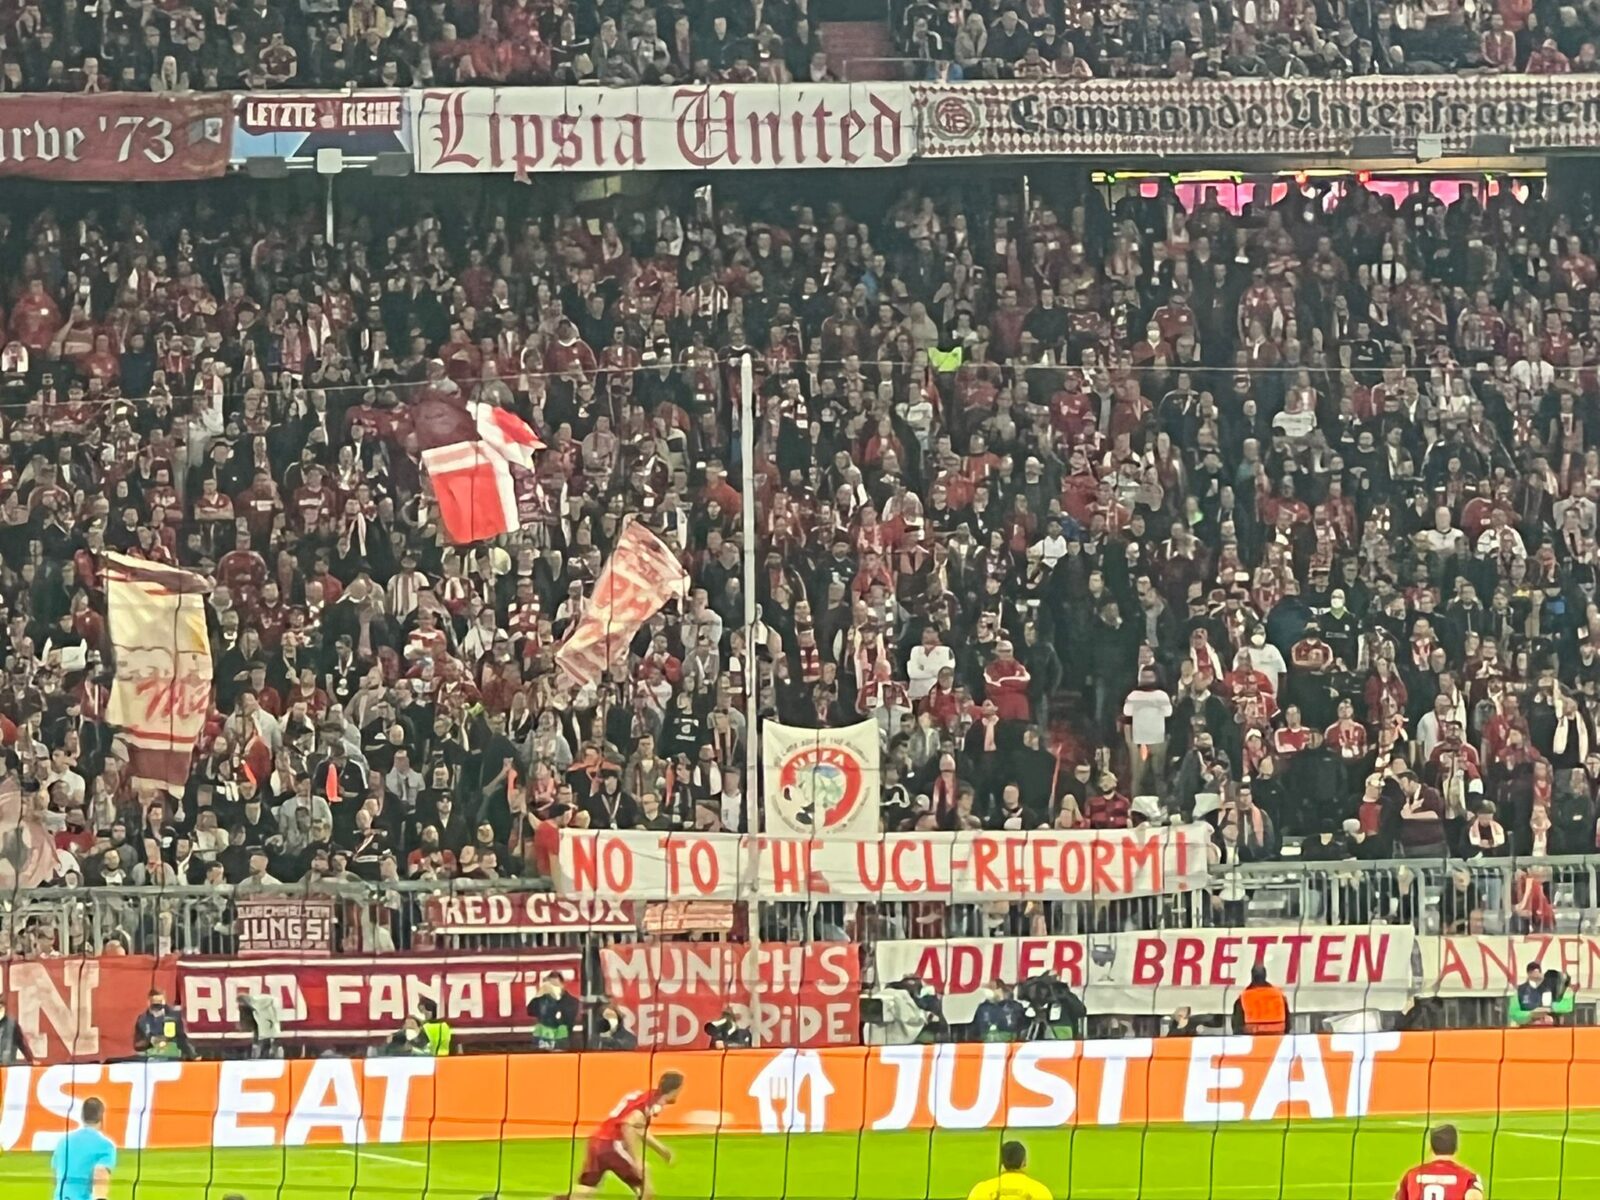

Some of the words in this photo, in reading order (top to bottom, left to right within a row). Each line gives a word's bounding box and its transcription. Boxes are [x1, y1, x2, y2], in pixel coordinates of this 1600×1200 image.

[0, 120, 85, 162] rve
[99, 115, 175, 164] '73
[246, 102, 317, 128] LETZTE
[421, 87, 646, 185] Lipsia
[672, 86, 902, 168] United
[792, 750, 845, 768] UEFA
[572, 836, 633, 893] NO
[658, 838, 719, 895] TO
[239, 918, 330, 940] JUNGS!
[439, 894, 513, 924] RED
[915, 940, 1083, 994] ADLER
[1132, 933, 1390, 985] BRETTEN
[212, 1057, 436, 1147] EAT
[873, 1038, 1152, 1130] JUST
[1183, 1032, 1401, 1122] EAT
